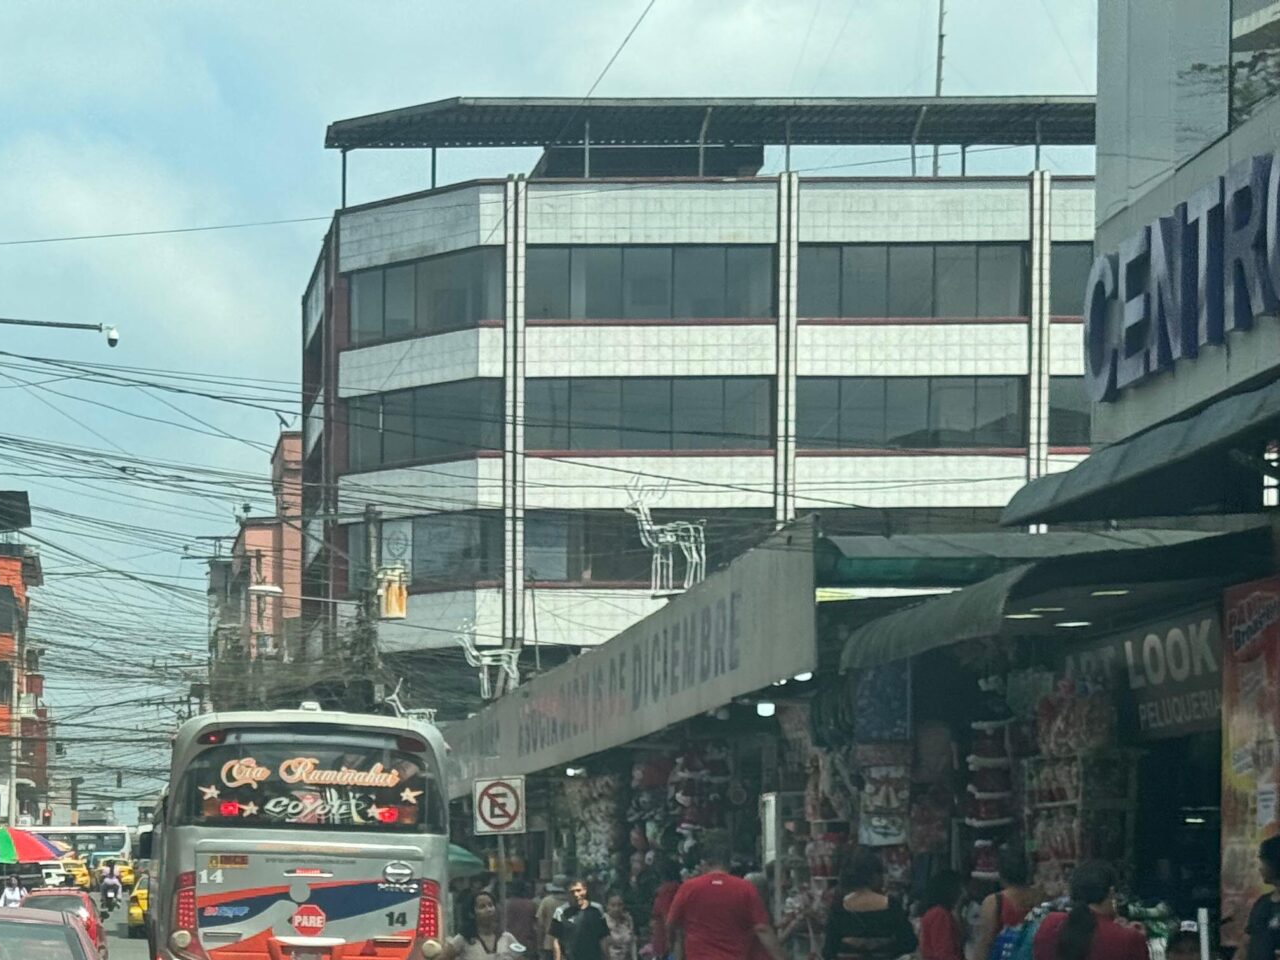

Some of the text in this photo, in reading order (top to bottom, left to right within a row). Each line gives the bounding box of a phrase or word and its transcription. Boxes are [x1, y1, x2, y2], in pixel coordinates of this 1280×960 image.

[1084, 153, 1280, 403] CENTR
[631, 590, 743, 713] DICIEMBRE
[1125, 618, 1218, 690] LOOK
[198, 869, 224, 884] 14
[294, 914, 323, 928] PARE
[385, 912, 407, 927] 14
